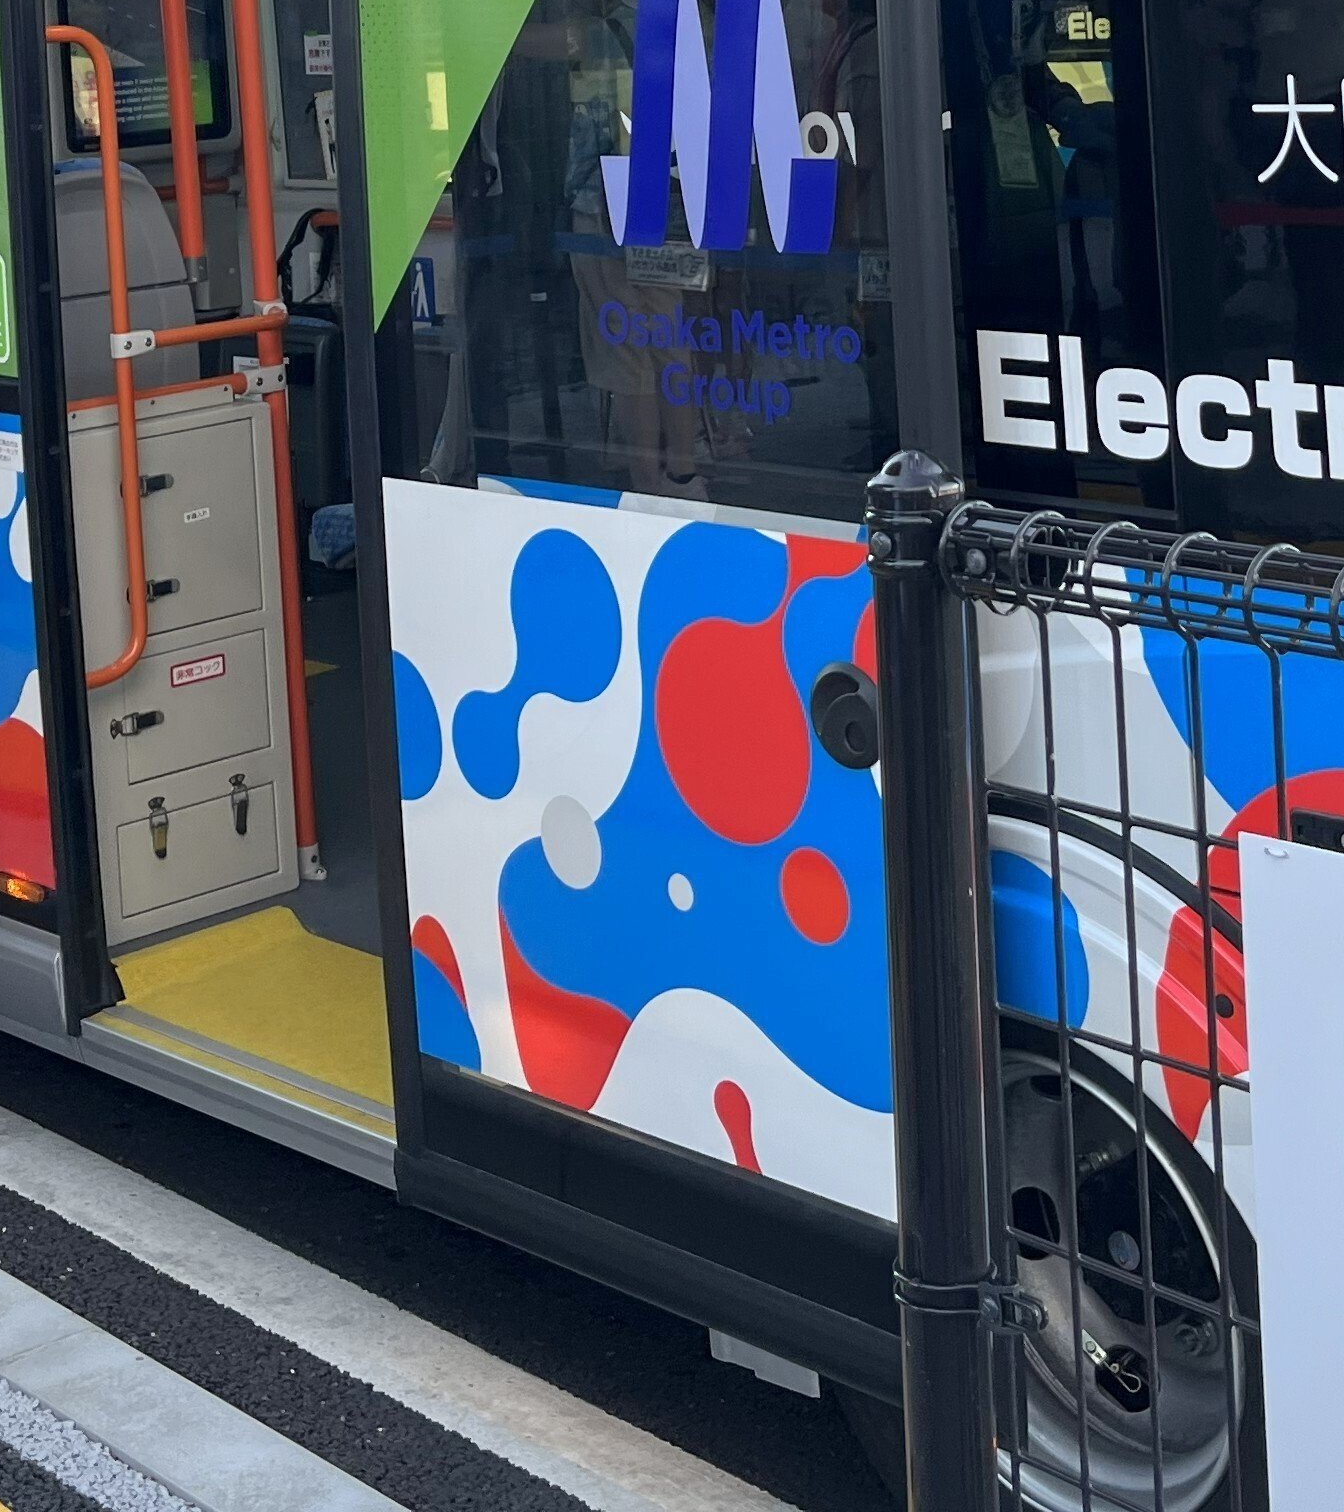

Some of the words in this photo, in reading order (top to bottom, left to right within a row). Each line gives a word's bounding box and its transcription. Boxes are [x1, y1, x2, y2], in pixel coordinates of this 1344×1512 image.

[597, 300, 723, 353] Osaka
[730, 309, 863, 365] Metro
[660, 360, 792, 426] Group
